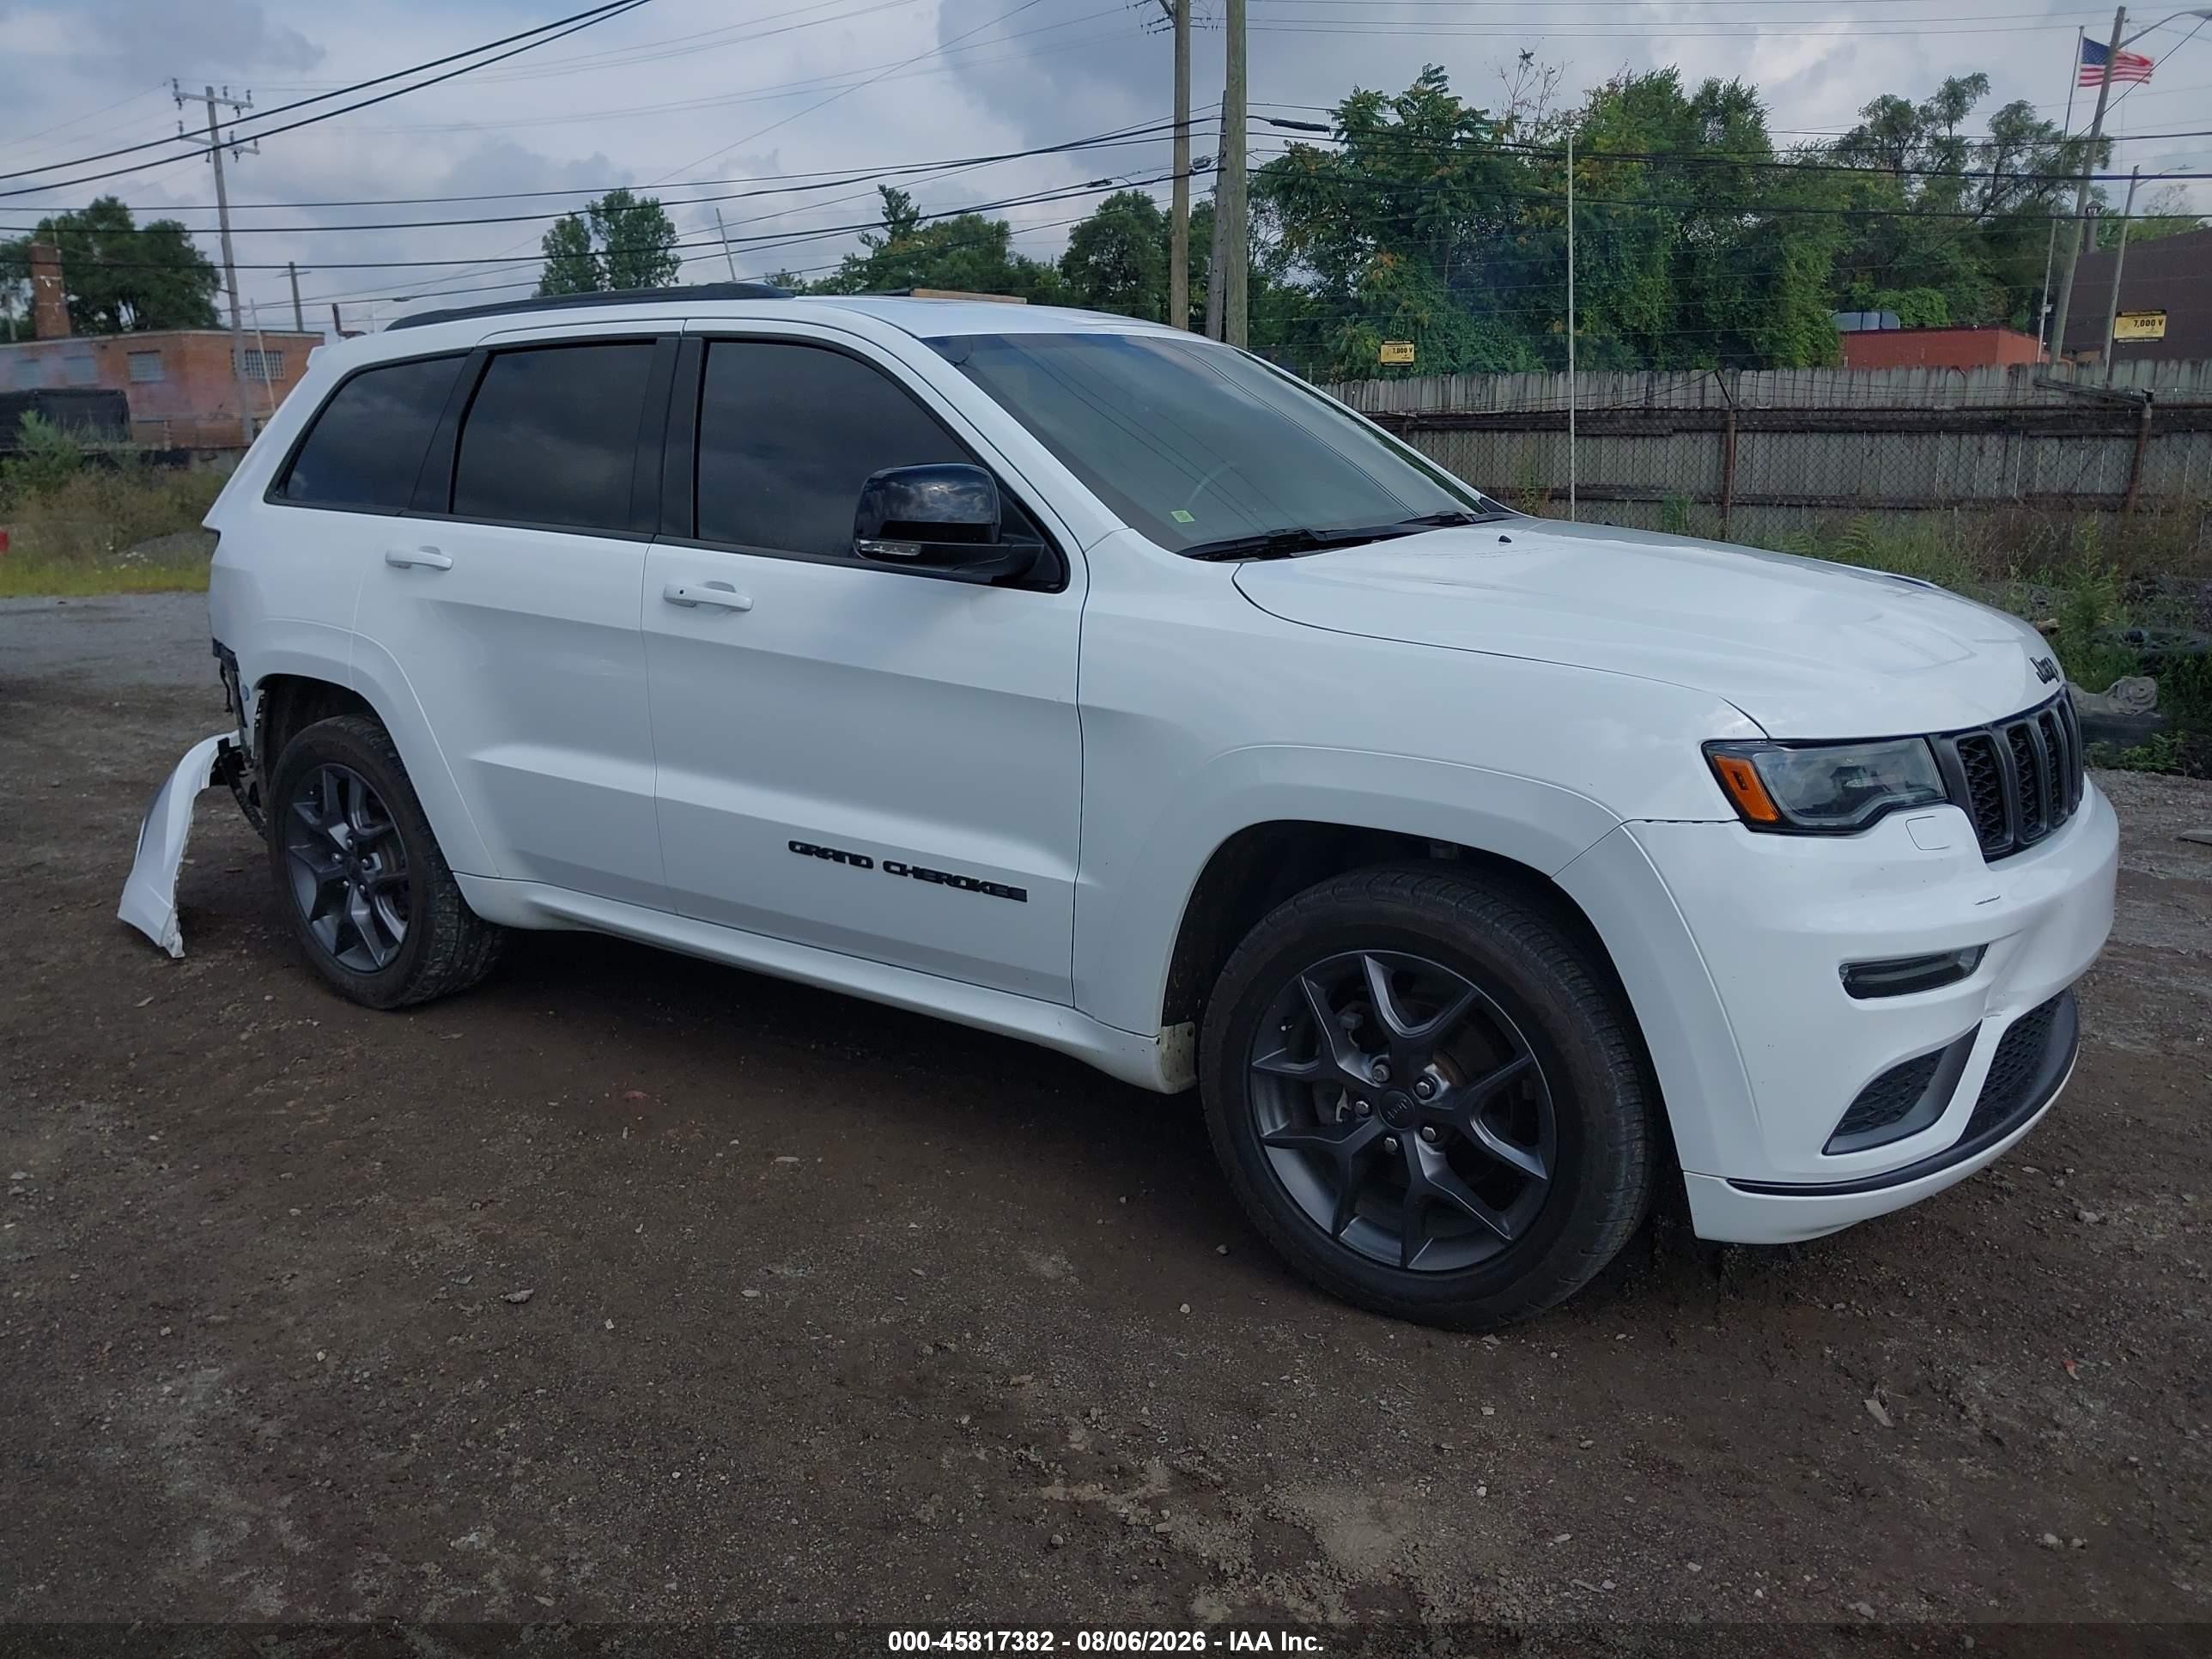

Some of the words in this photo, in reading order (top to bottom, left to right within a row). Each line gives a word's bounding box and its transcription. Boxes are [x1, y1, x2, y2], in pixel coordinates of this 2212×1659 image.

[2133, 319, 2156, 328] 7,000
[788, 840, 874, 869] GRAND
[883, 860, 1028, 902] CHEROKEE
